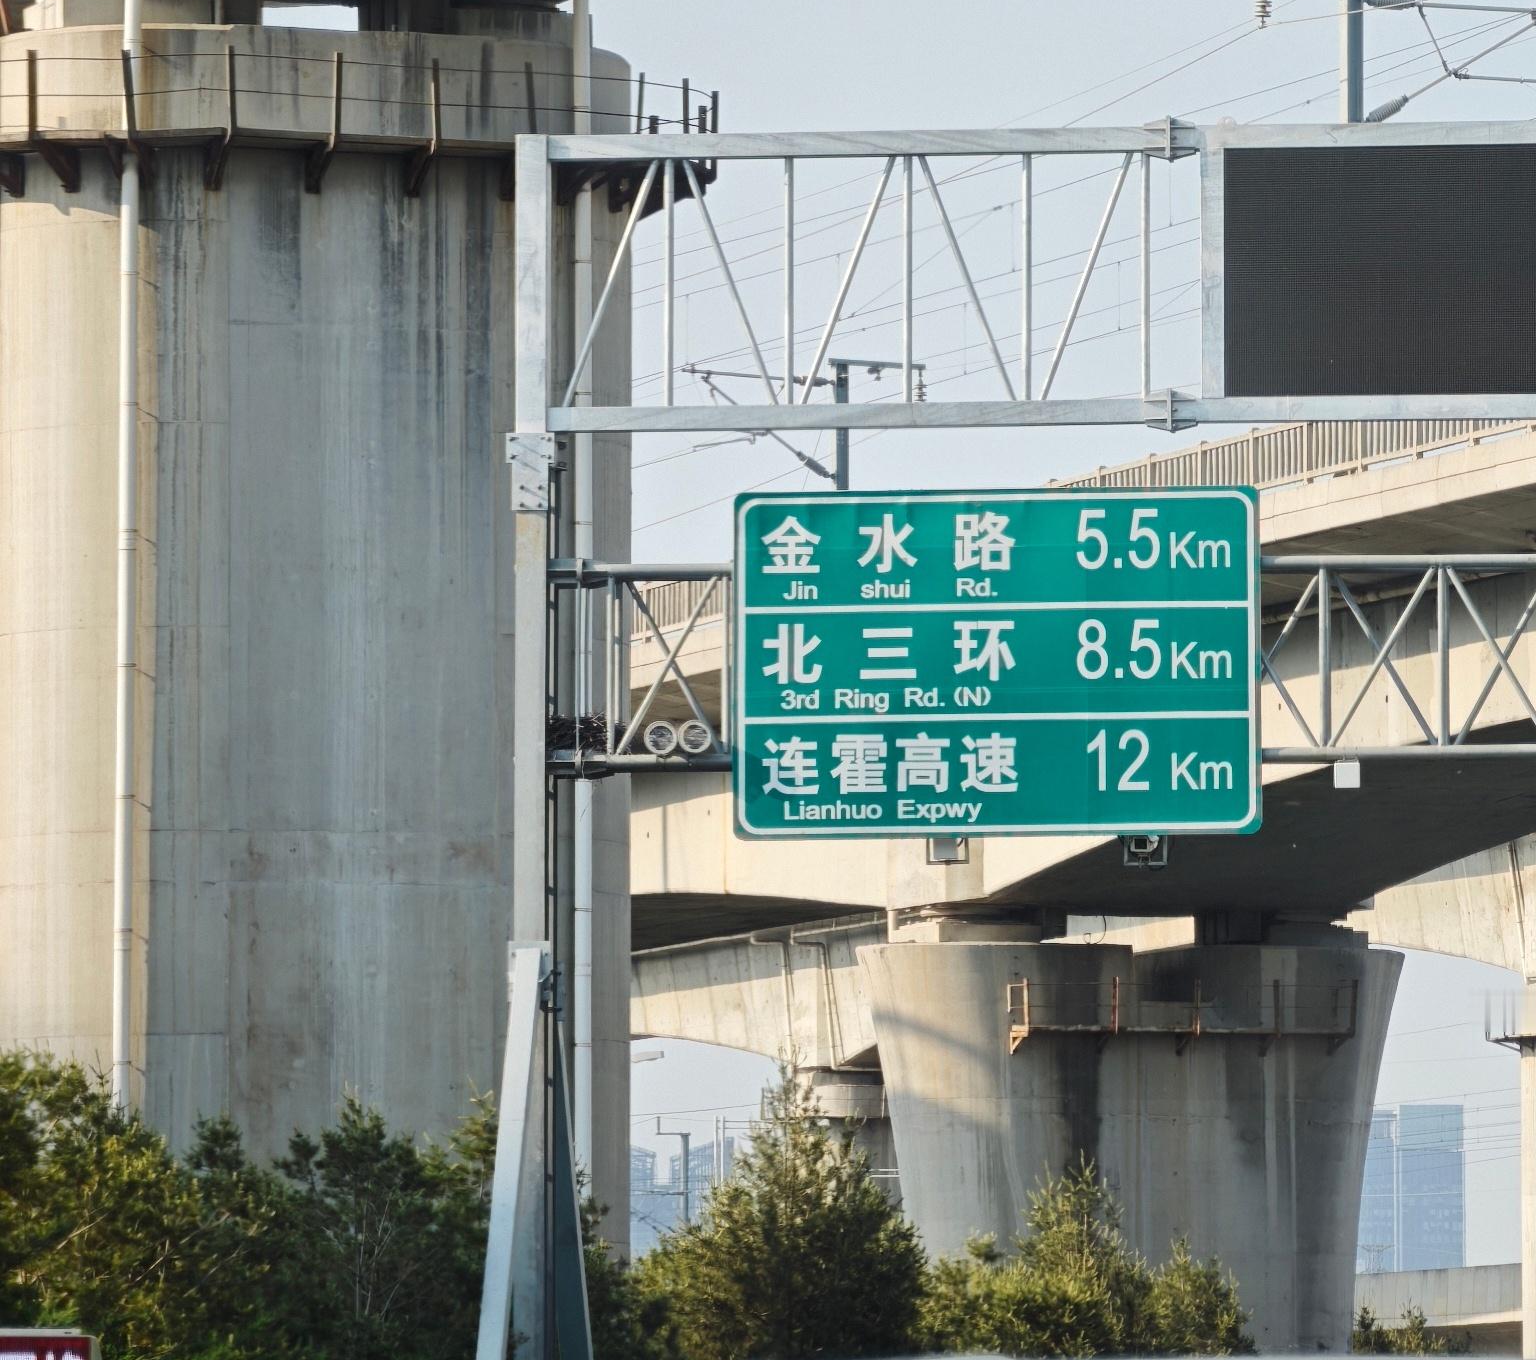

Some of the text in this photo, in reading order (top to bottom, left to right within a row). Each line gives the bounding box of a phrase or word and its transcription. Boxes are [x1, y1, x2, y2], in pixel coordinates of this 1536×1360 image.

[762, 512, 1015, 573] 金水路
[784, 578, 997, 599] Jin shui Rd.
[763, 621, 1015, 682] 北三环
[781, 687, 991, 713] 3rd Ring Rd. (N)
[763, 729, 1232, 794] 连霍高速 12 Km
[784, 800, 982, 823] Lianhuo Expwy
